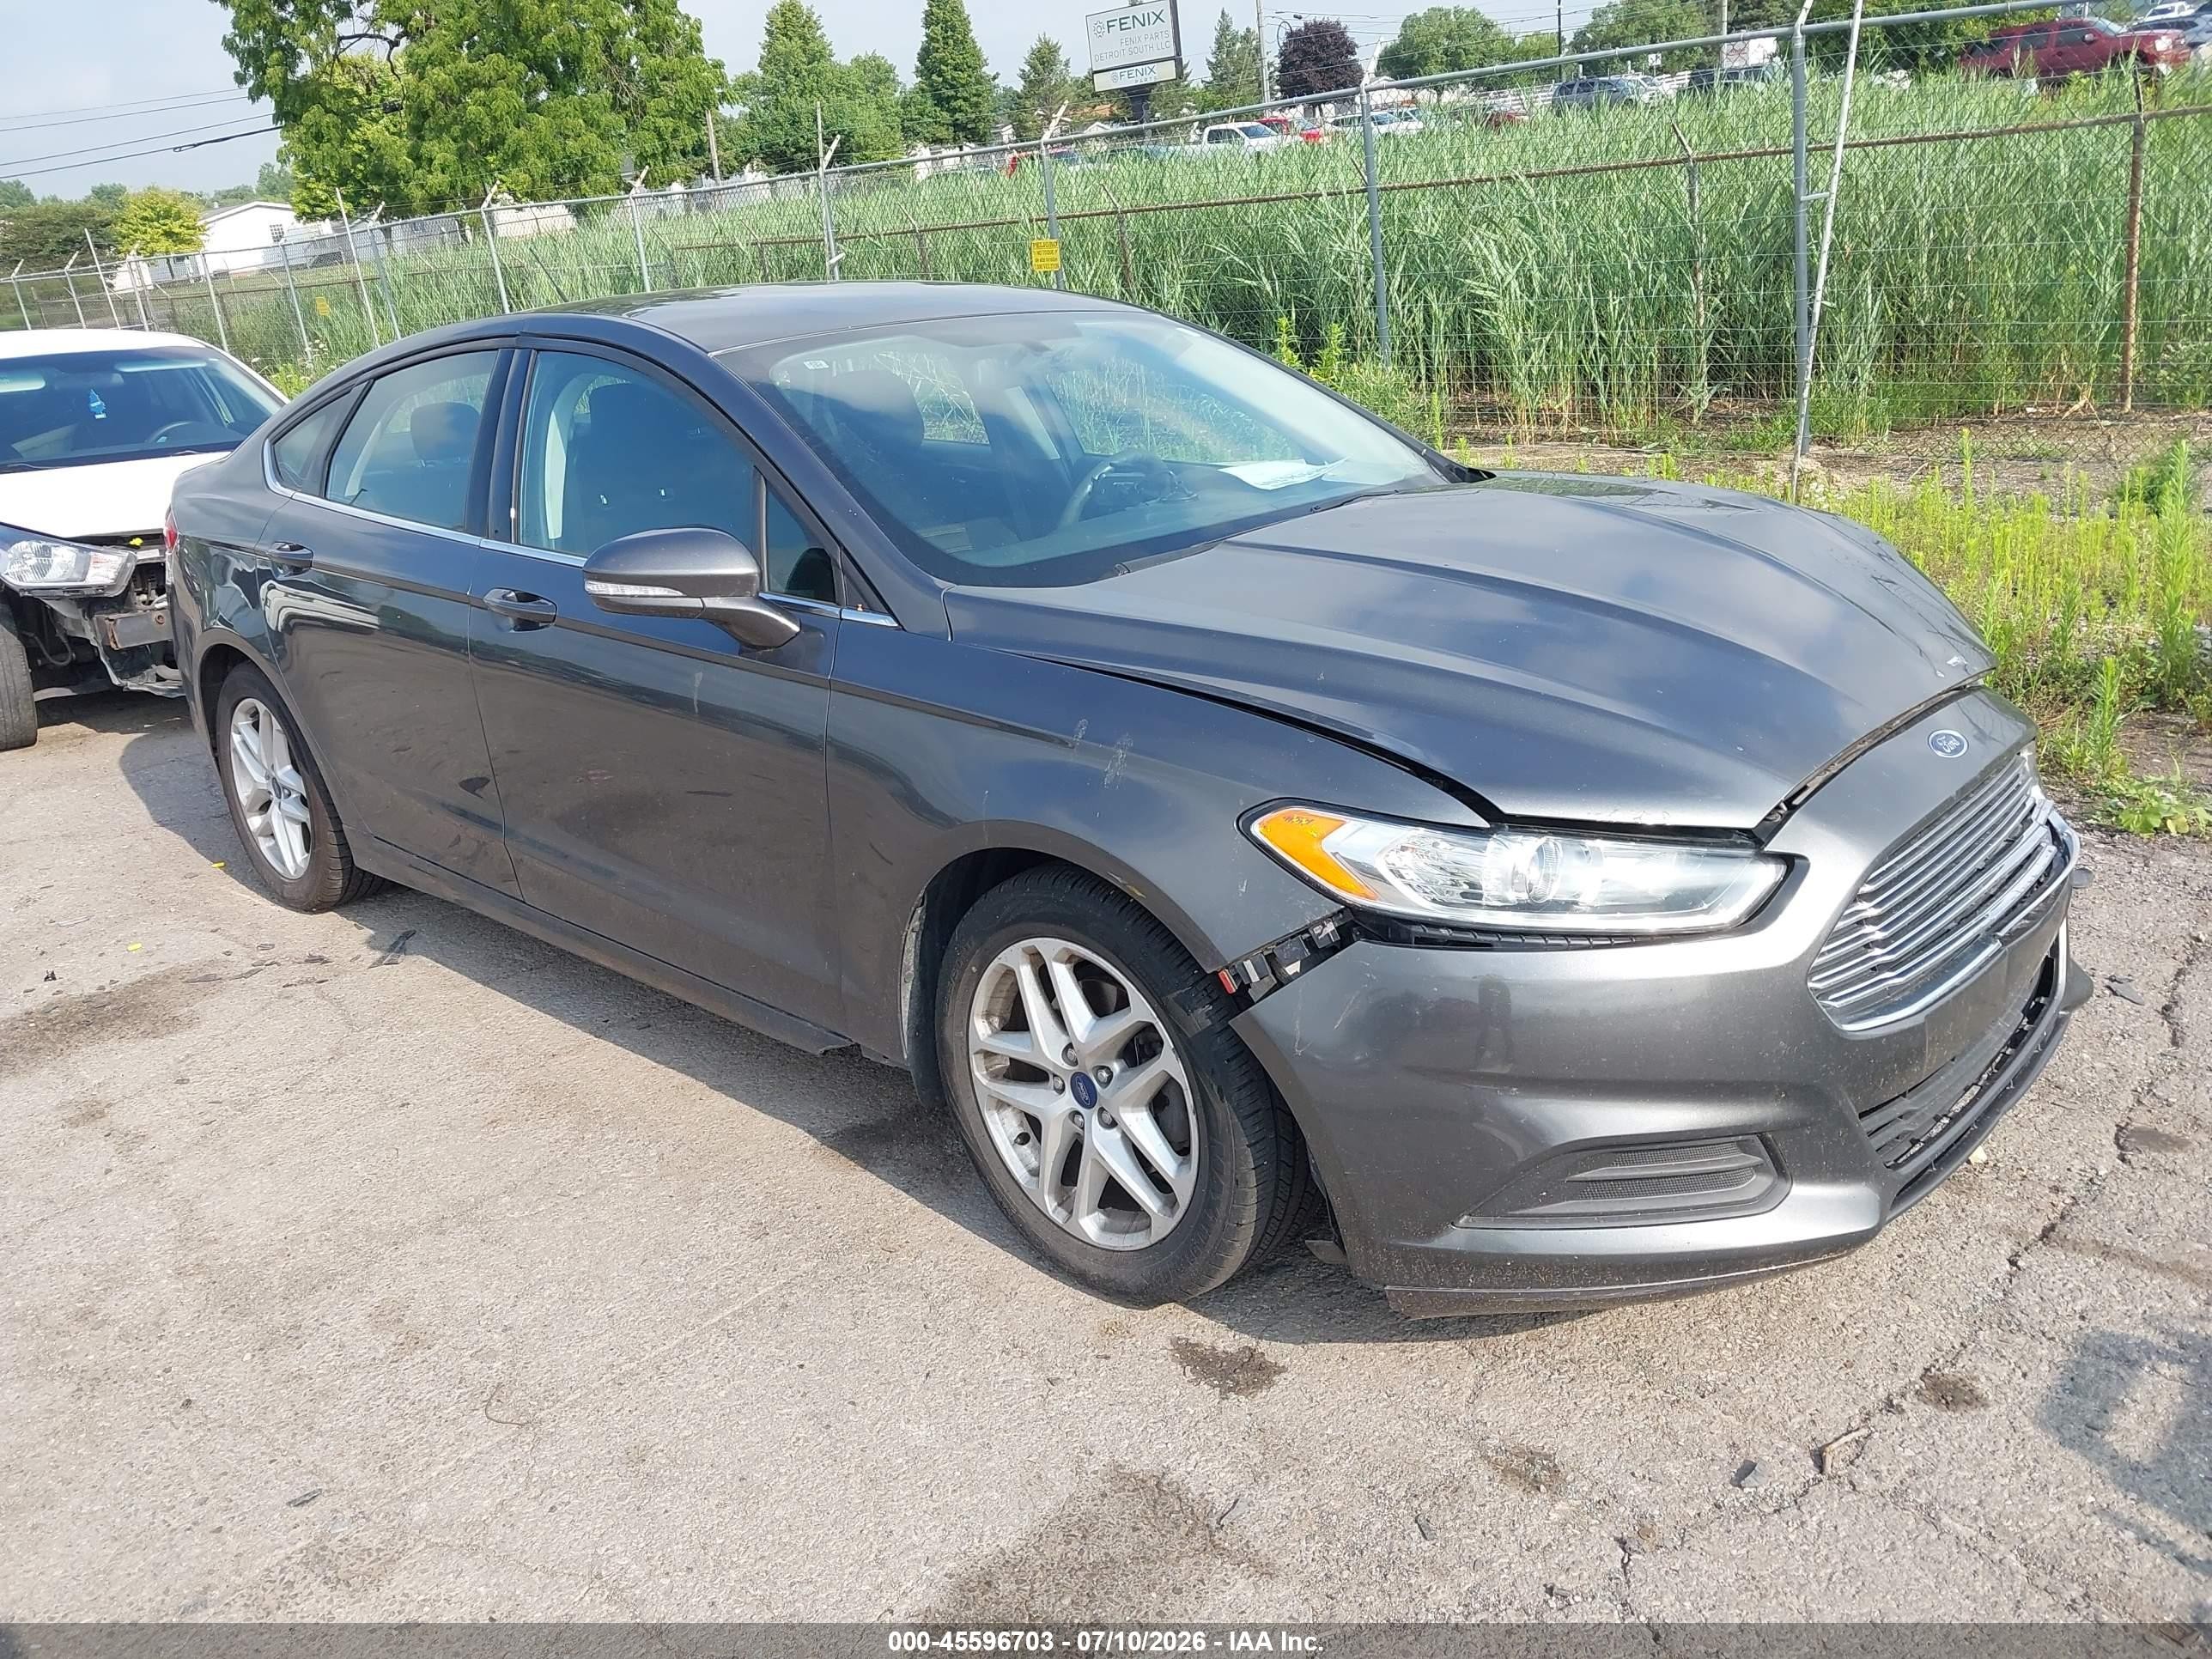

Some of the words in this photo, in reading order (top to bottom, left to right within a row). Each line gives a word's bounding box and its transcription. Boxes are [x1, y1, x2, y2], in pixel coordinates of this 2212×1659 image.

[1106, 9, 1165, 34] FENIX
[1120, 36, 1142, 48] FENIX
[1144, 30, 1170, 43] PARTS
[1094, 48, 1126, 63] DETROIT
[1128, 44, 1154, 56] SOUTH
[1156, 40, 1170, 51] LLC
[1119, 64, 1156, 81] FENIX
[1936, 735, 1960, 753] Ford
